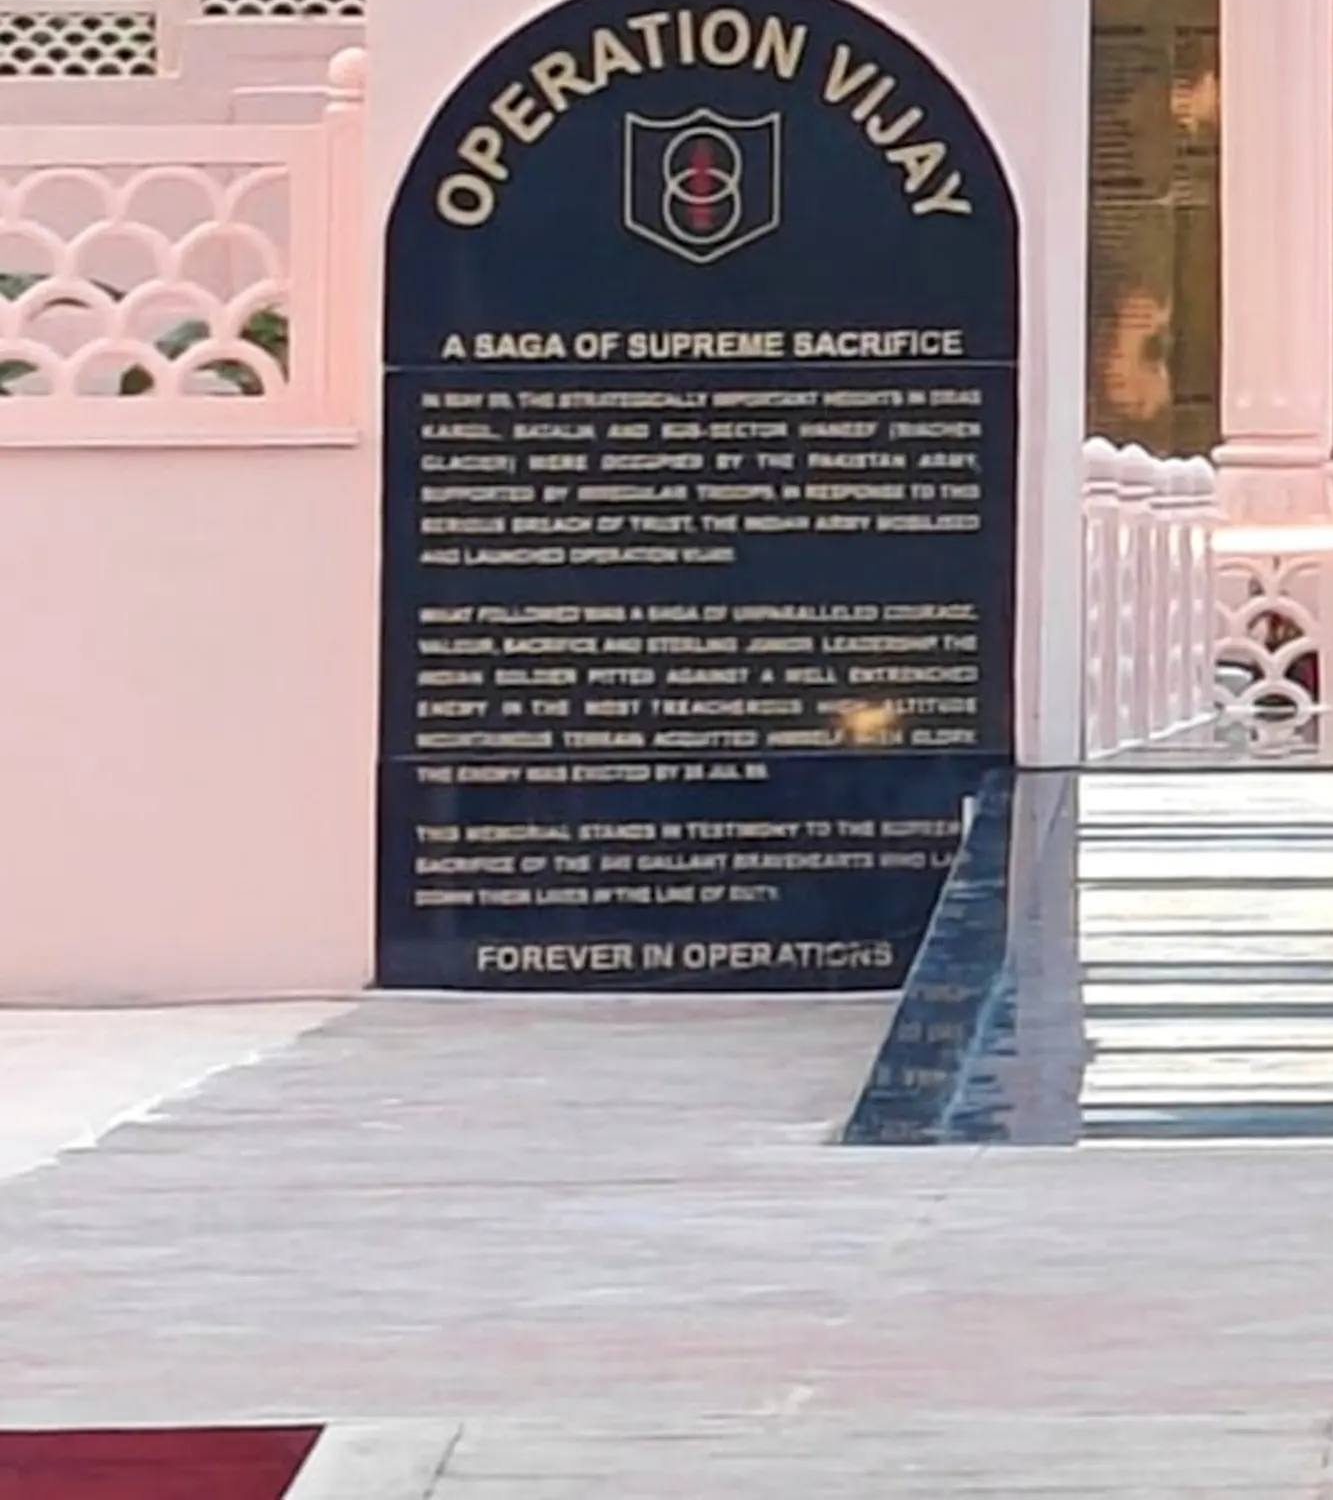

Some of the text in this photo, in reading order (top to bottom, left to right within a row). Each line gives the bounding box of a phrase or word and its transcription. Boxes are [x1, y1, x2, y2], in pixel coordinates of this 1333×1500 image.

[437, 8, 807, 226] OPERATION
[825, 44, 972, 215] VIJAY
[442, 330, 962, 359] A SAGA OF SUPREME SACRIFICE
[477, 942, 892, 971] FOREVER IN OPERATIONS
